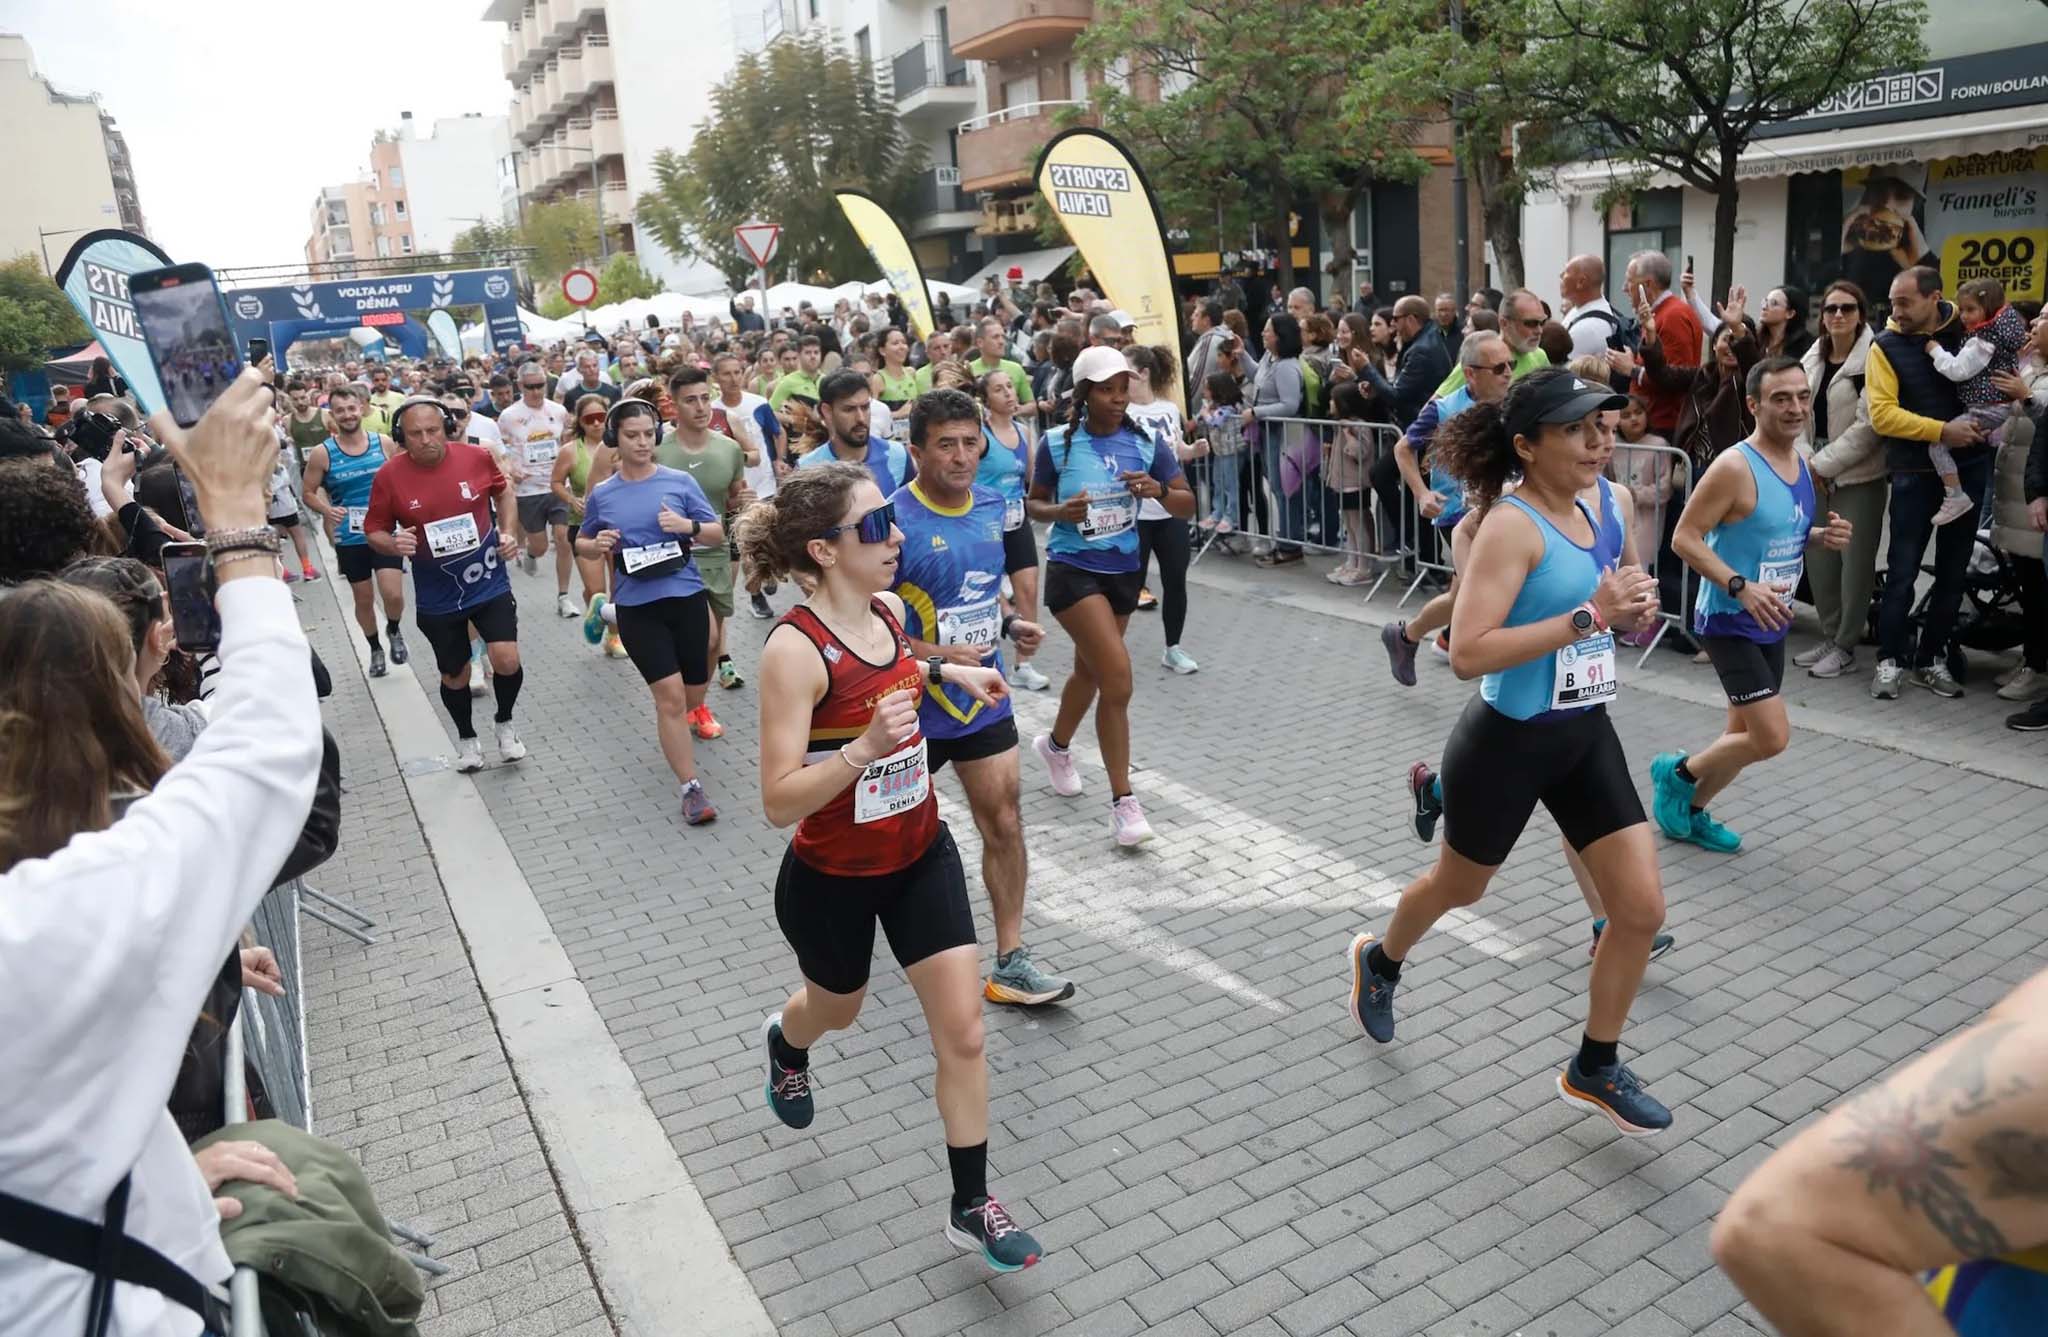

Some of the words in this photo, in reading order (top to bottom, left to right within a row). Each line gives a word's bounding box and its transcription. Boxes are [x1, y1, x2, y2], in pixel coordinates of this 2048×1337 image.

[1943, 160, 2035, 178] APERTURA
[1940, 186, 2037, 212] Fanneli's
[1993, 206, 2036, 218] burgers
[1958, 236, 2035, 268] 200
[1957, 265, 2033, 280] BURGERS
[338, 286, 378, 298] VOLTA
[379, 285, 387, 295] A
[389, 284, 413, 295] PEU
[446, 533, 465, 544] 453
[965, 628, 988, 644] 979
[1566, 673, 1574, 687] B
[1588, 664, 1604, 684] 91
[888, 762, 906, 774] SOM
